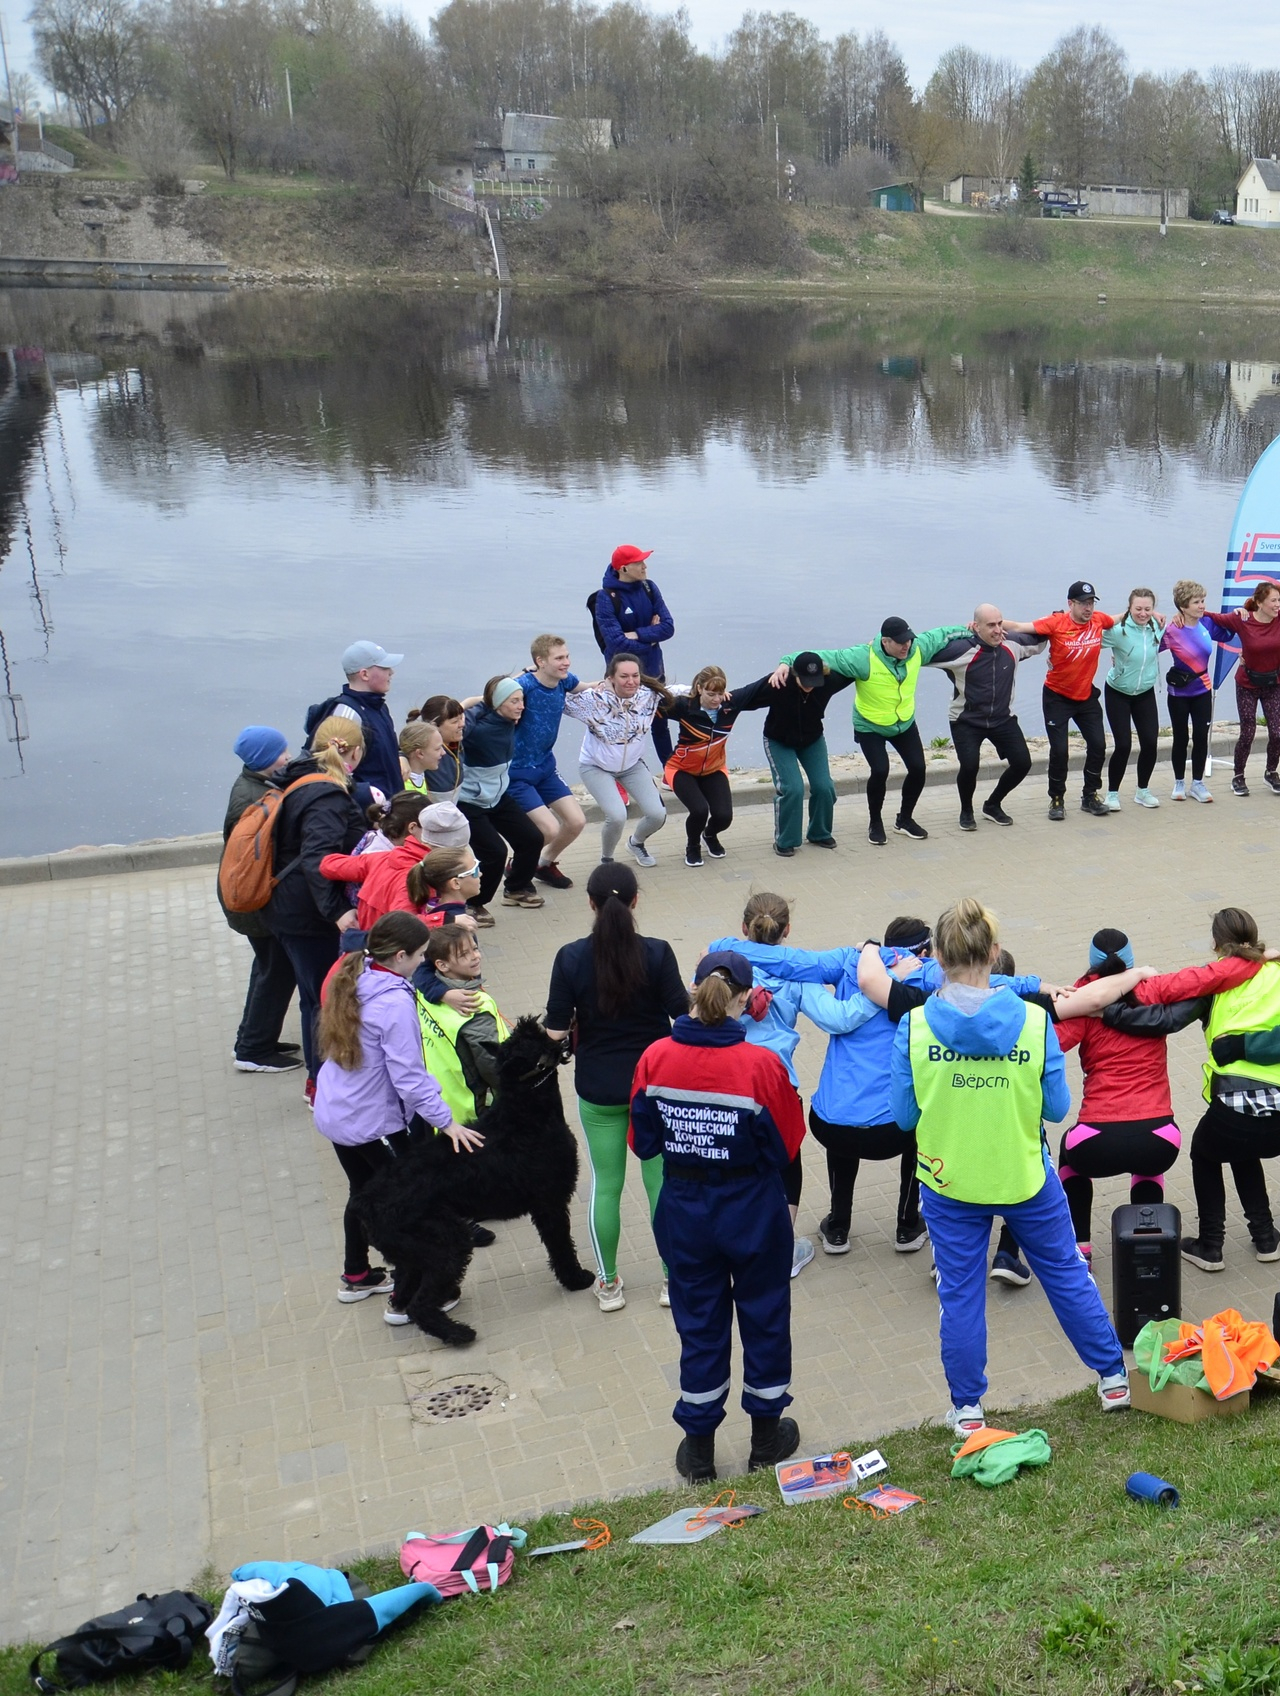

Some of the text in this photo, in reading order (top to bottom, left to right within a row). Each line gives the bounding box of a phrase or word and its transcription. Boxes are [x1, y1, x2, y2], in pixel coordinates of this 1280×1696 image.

[661, 1113, 735, 1136] СУДЕНЧЕСКИЙ
[674, 1131, 715, 1146] КОРПУС
[664, 1141, 729, 1160] СПАСАТЕЛЕЙ
